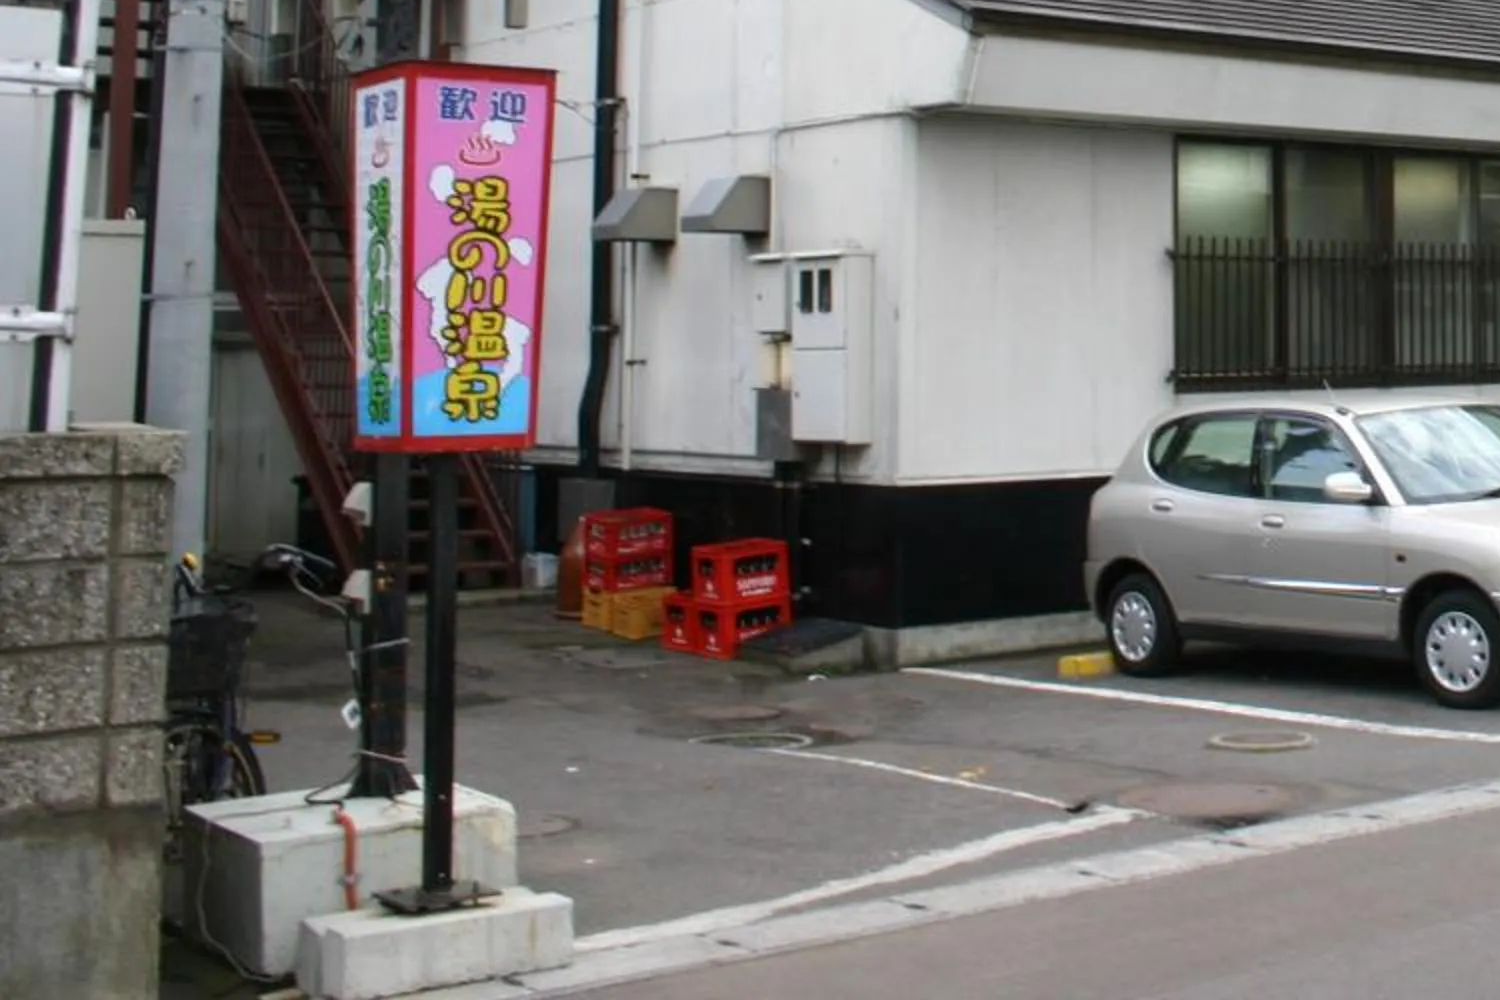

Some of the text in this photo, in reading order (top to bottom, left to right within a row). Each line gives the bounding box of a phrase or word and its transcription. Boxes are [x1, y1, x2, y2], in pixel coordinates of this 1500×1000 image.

[364, 88, 398, 128] 歓迎
[440, 85, 527, 123] 歓迎
[368, 177, 391, 423] 湯の川温泉
[443, 176, 511, 422] 湯の川温泉
